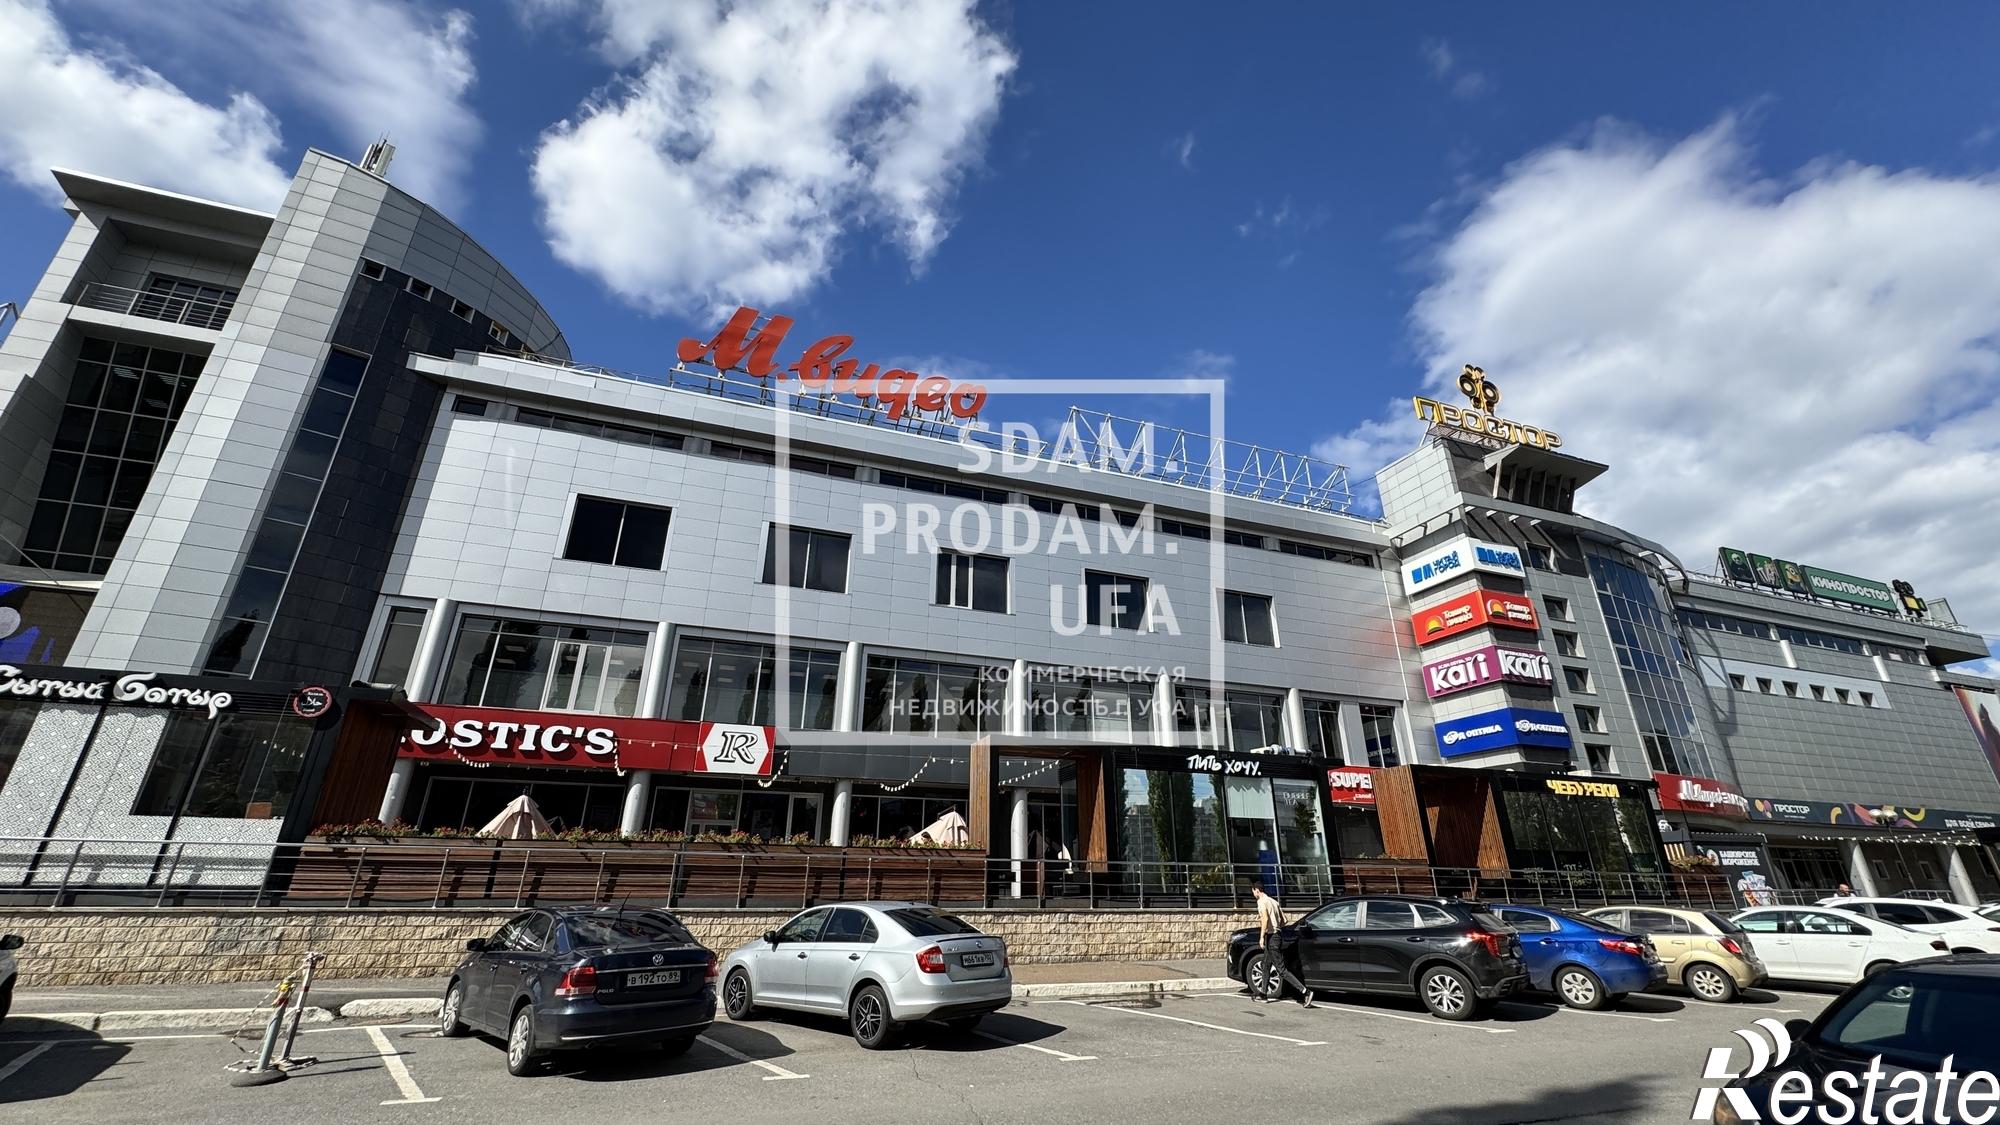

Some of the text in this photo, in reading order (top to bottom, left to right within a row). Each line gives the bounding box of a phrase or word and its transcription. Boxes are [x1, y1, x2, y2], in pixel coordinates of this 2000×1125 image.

[1413, 396, 1562, 450] ПРОСТОР
[1811, 576, 1889, 601] КИНОПРОСТОР
[1430, 653, 1489, 691] kari
[1497, 649, 1552, 680] kari
[113, 672, 232, 720] Батыр
[411, 717, 615, 755] OSTIC'S
[1466, 724, 1503, 738] ОПТИКА
[1186, 754, 1222, 771] ПИТЬ
[1330, 771, 1373, 789] SUPE
[1546, 779, 1620, 797] ЧЕБУРЕКИ
[1774, 804, 1810, 814] ПРОСТОР
